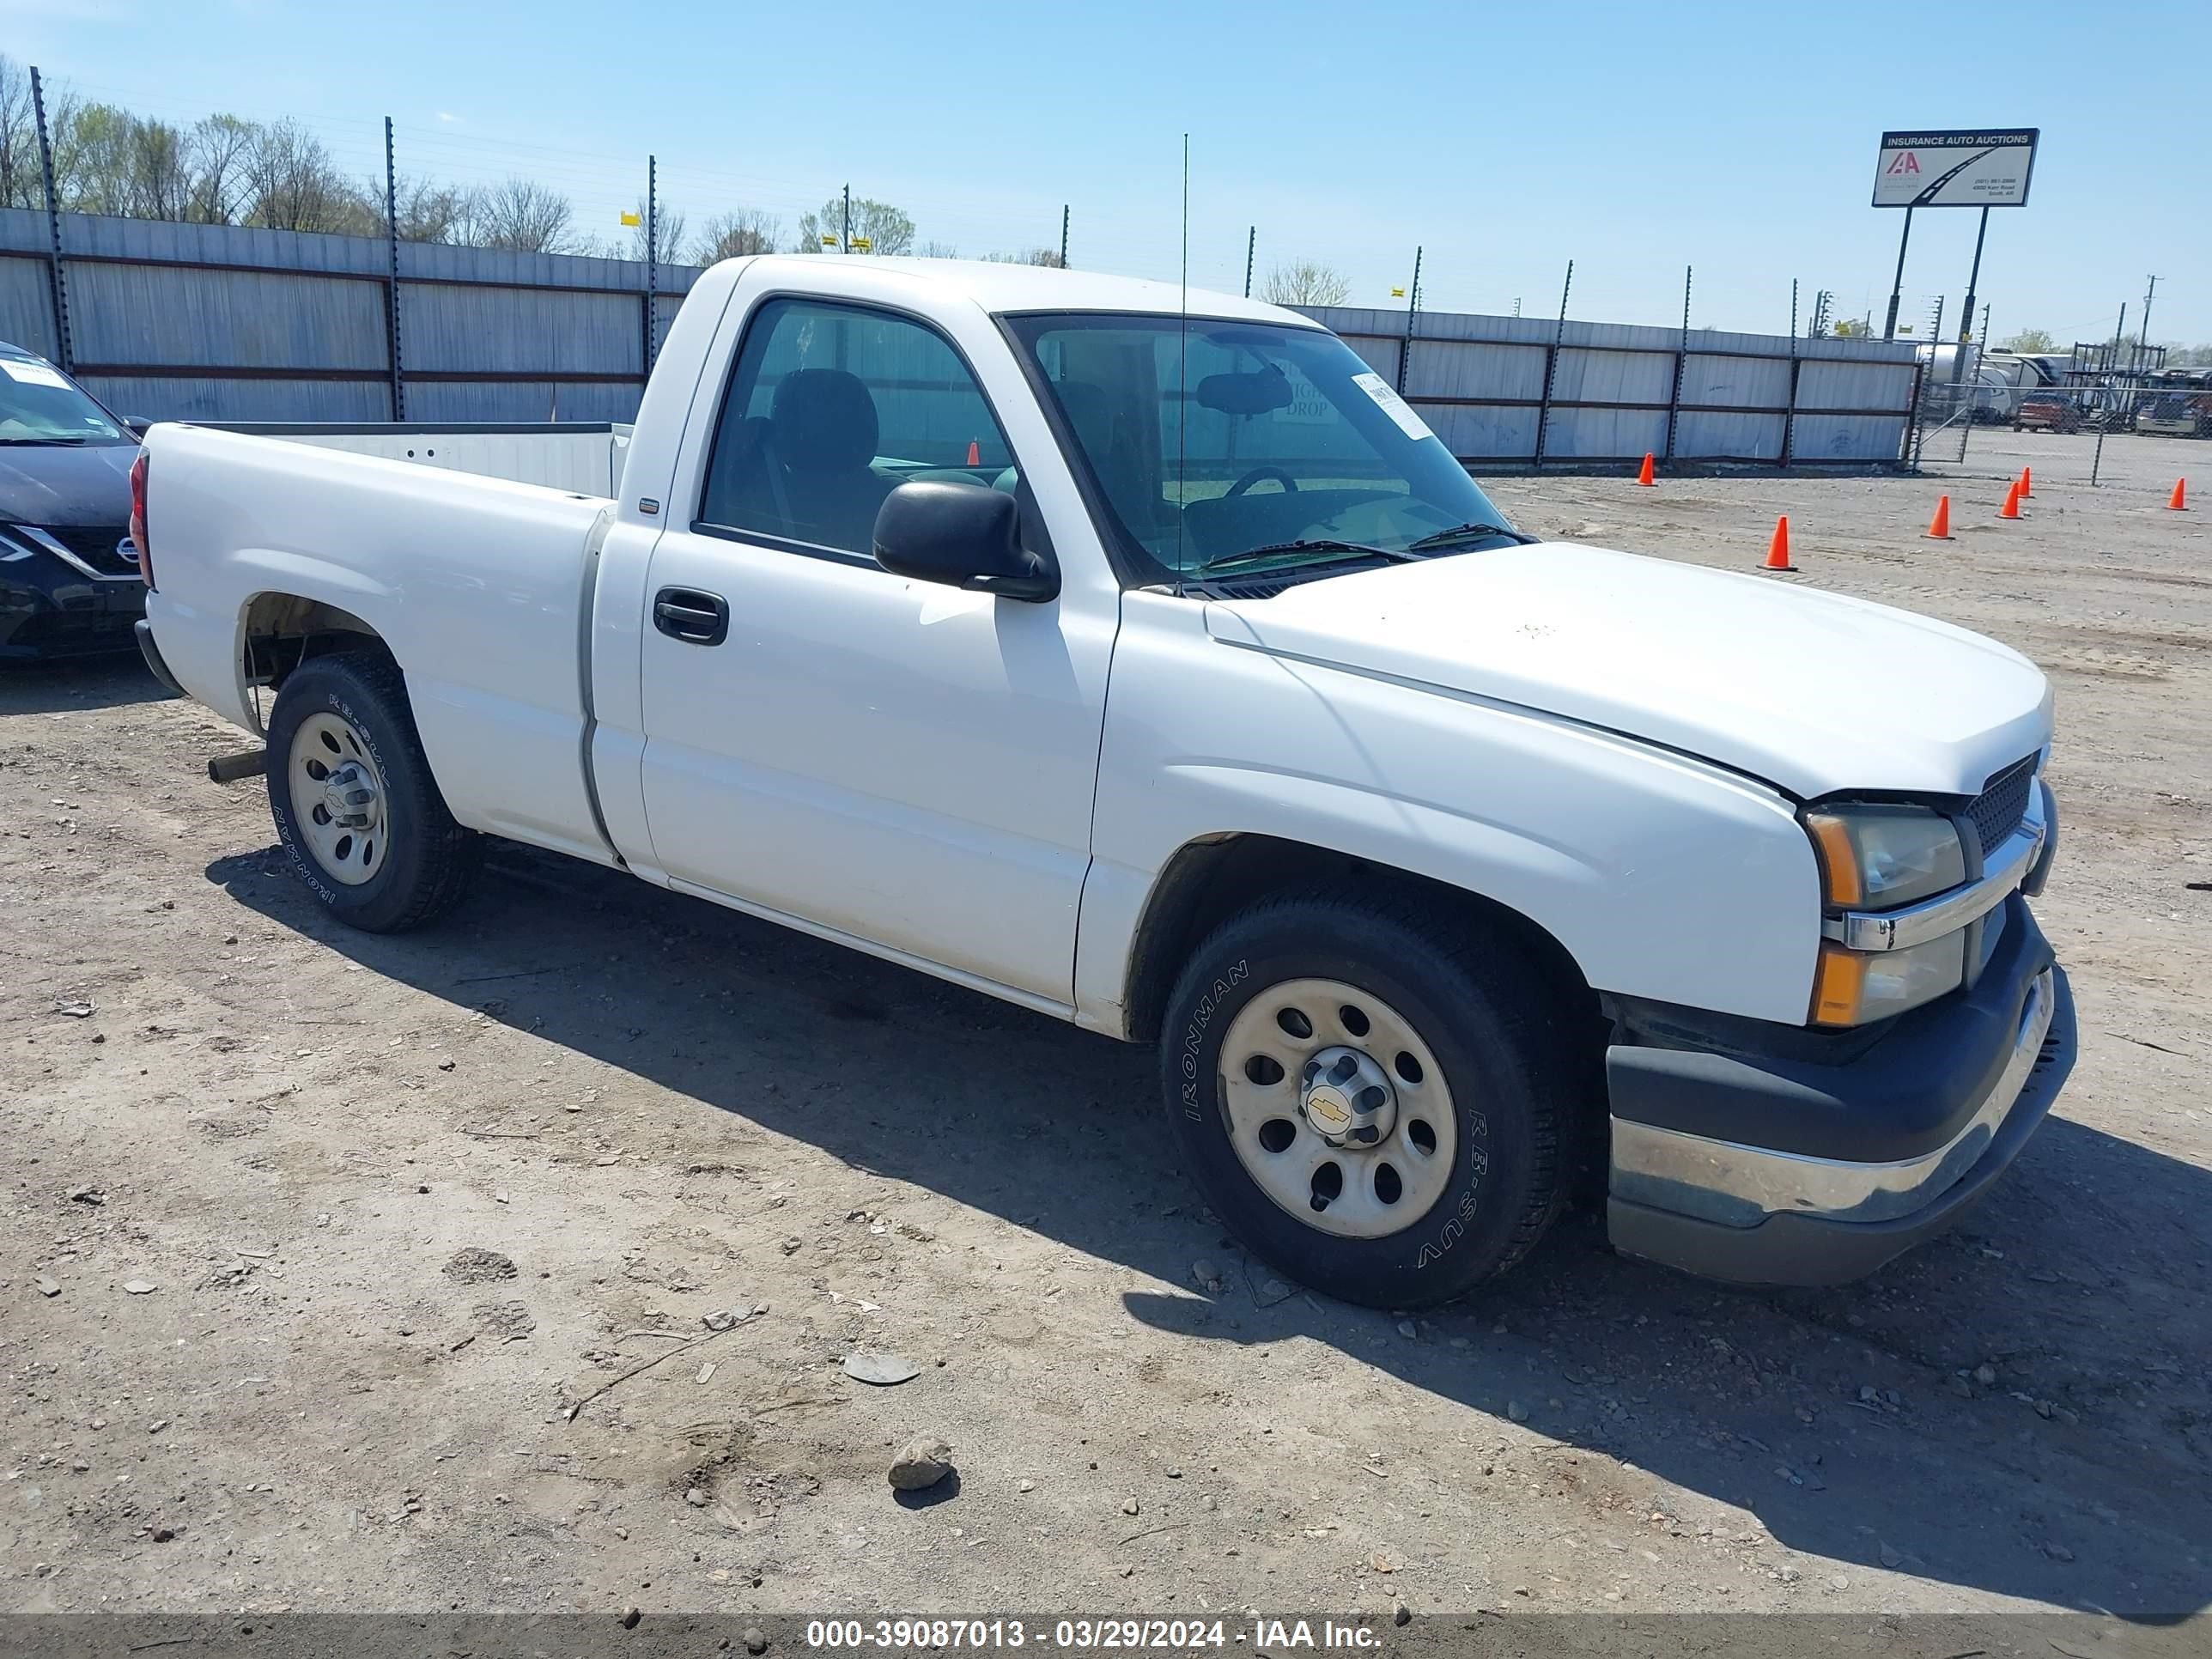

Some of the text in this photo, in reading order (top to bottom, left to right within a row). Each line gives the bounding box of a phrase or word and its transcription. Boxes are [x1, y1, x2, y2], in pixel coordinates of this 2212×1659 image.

[1887, 135, 2028, 146] INSURANCE AUTO AUCTIONS
[1286, 402, 1327, 416] DROP
[274, 805, 337, 904] IRONMAN
[1182, 959, 1250, 1122] IRONMAN
